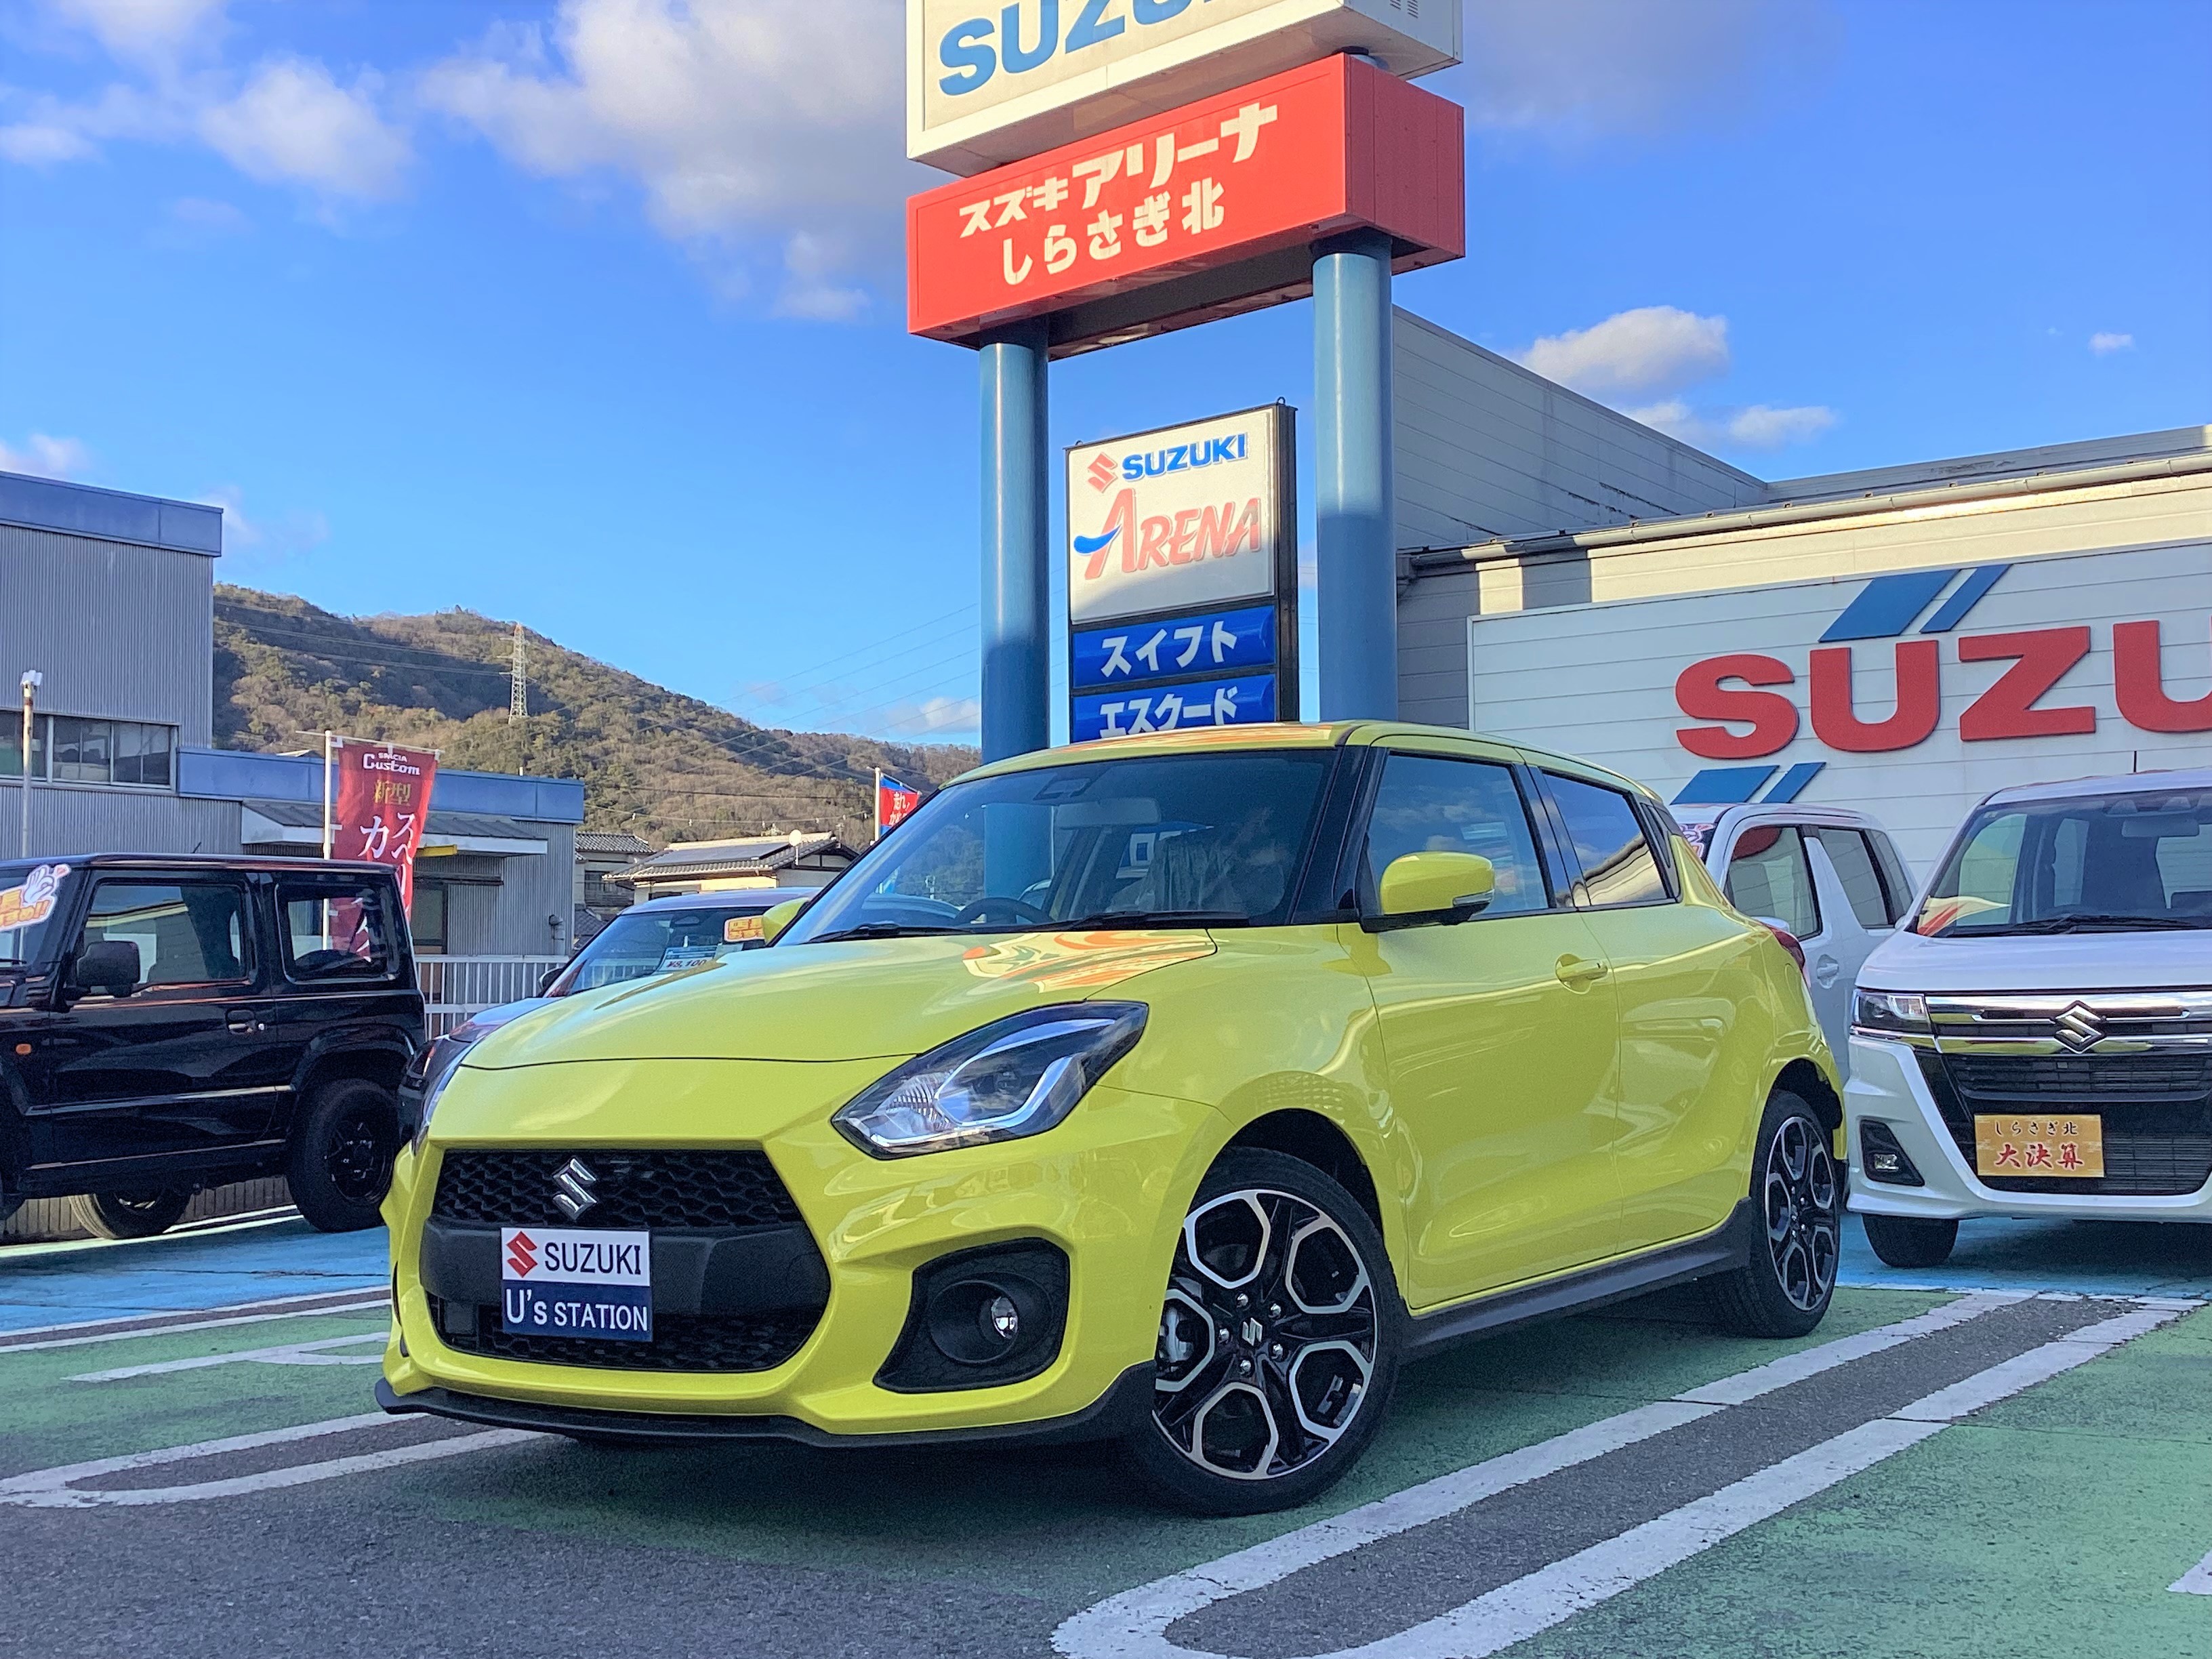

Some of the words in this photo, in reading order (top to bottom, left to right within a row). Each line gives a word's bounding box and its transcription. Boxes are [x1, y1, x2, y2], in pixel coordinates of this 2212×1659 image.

[939, 0, 1211, 96] SUZ
[959, 102, 1278, 239] スズキアリーナ
[1003, 177, 1225, 285] しらさぎ北
[1122, 432, 1248, 480] SUZUKI
[1073, 488, 1261, 580] ARENA
[1101, 620, 1237, 678] スイフト
[1099, 685, 1238, 739] エスクード
[1675, 615, 2212, 759] SUZU
[363, 753, 420, 775] Custom
[373, 779, 411, 806] 新型
[1994, 1120, 2079, 1136] しらさぎ北
[1994, 1143, 2083, 1171] 大決算
[544, 1242, 641, 1275] SUZUKI
[554, 1301, 648, 1332] STATION
